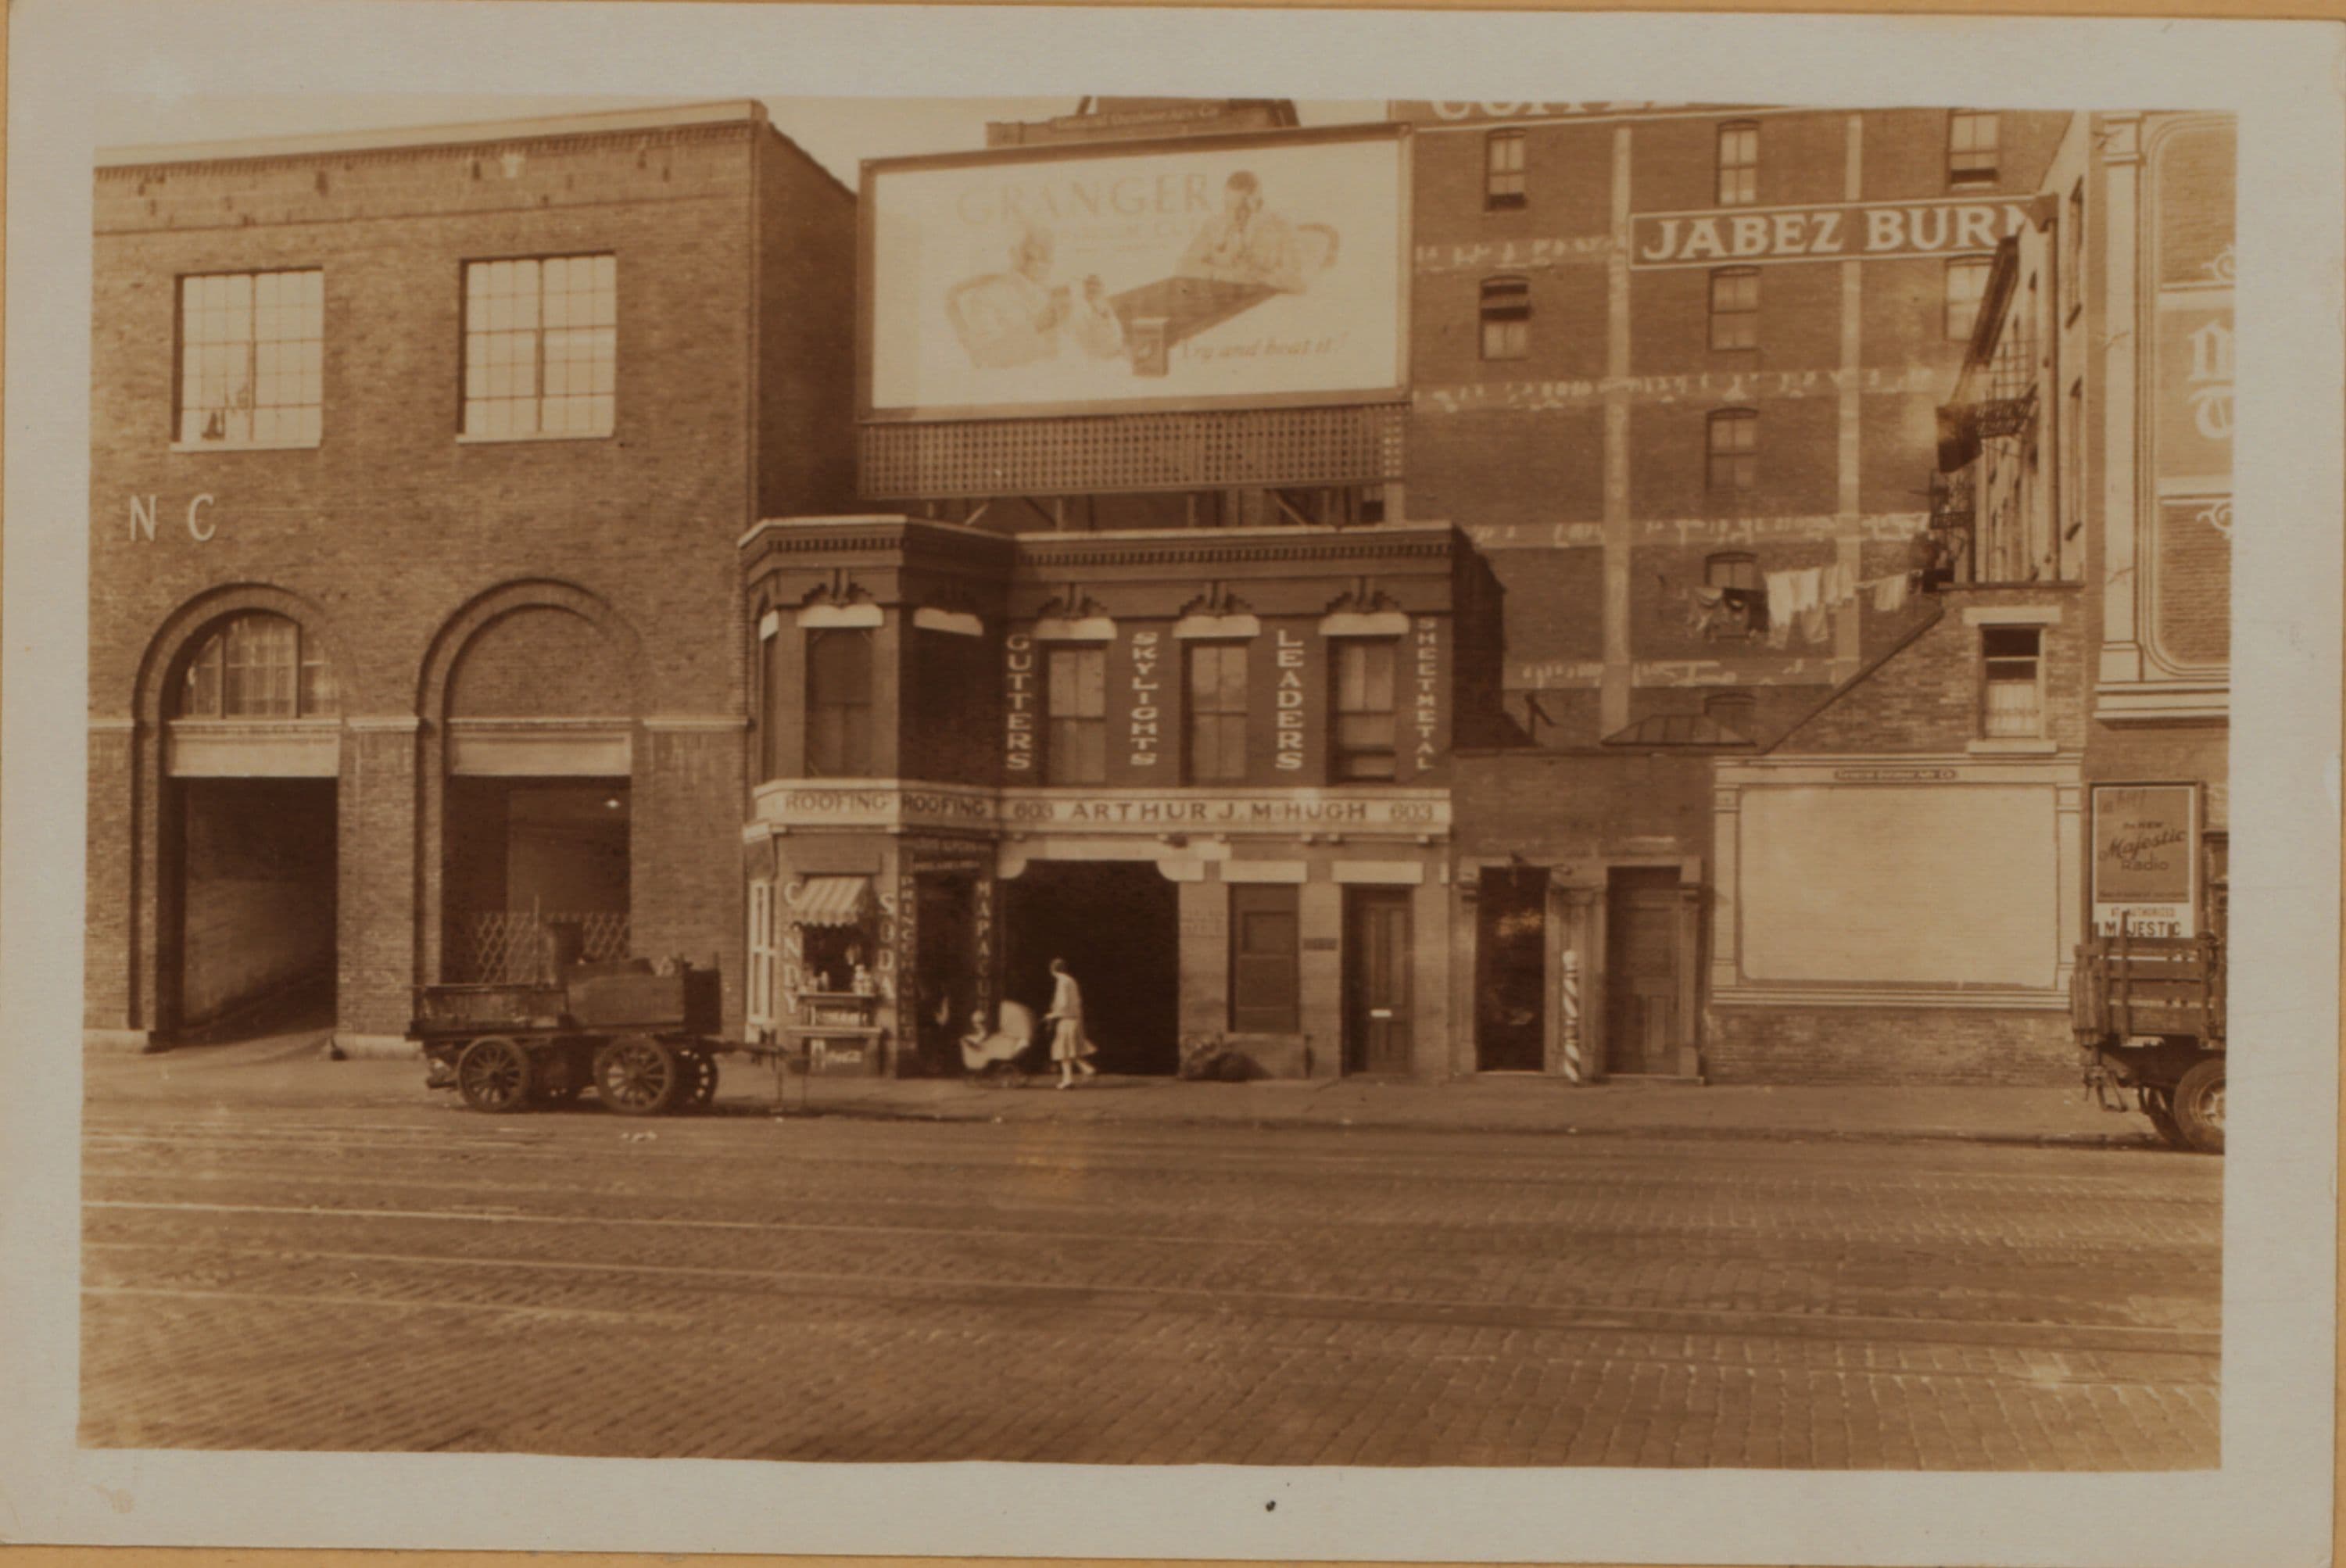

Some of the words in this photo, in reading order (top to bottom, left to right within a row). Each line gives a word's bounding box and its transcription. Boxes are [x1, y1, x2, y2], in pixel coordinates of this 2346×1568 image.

[956, 173, 1211, 226] GRANGER
[1642, 210, 1843, 261] JABEZ
[1006, 633, 1033, 771] GUTTERS
[1130, 631, 1159, 766] SKYLIGHTS
[1275, 628, 1305, 770] LEADERS
[785, 792, 888, 812] ROOFING
[901, 793, 987, 816] ROOFING
[1071, 802, 1208, 820] ARTHUR
[1390, 802, 1434, 820] 603
[2107, 828, 2187, 861] Majestic
[2120, 850, 2169, 871] Radio
[783, 881, 802, 1014] CNDY
[876, 892, 896, 1001] SODA
[2104, 921, 2181, 937] MJESTC
